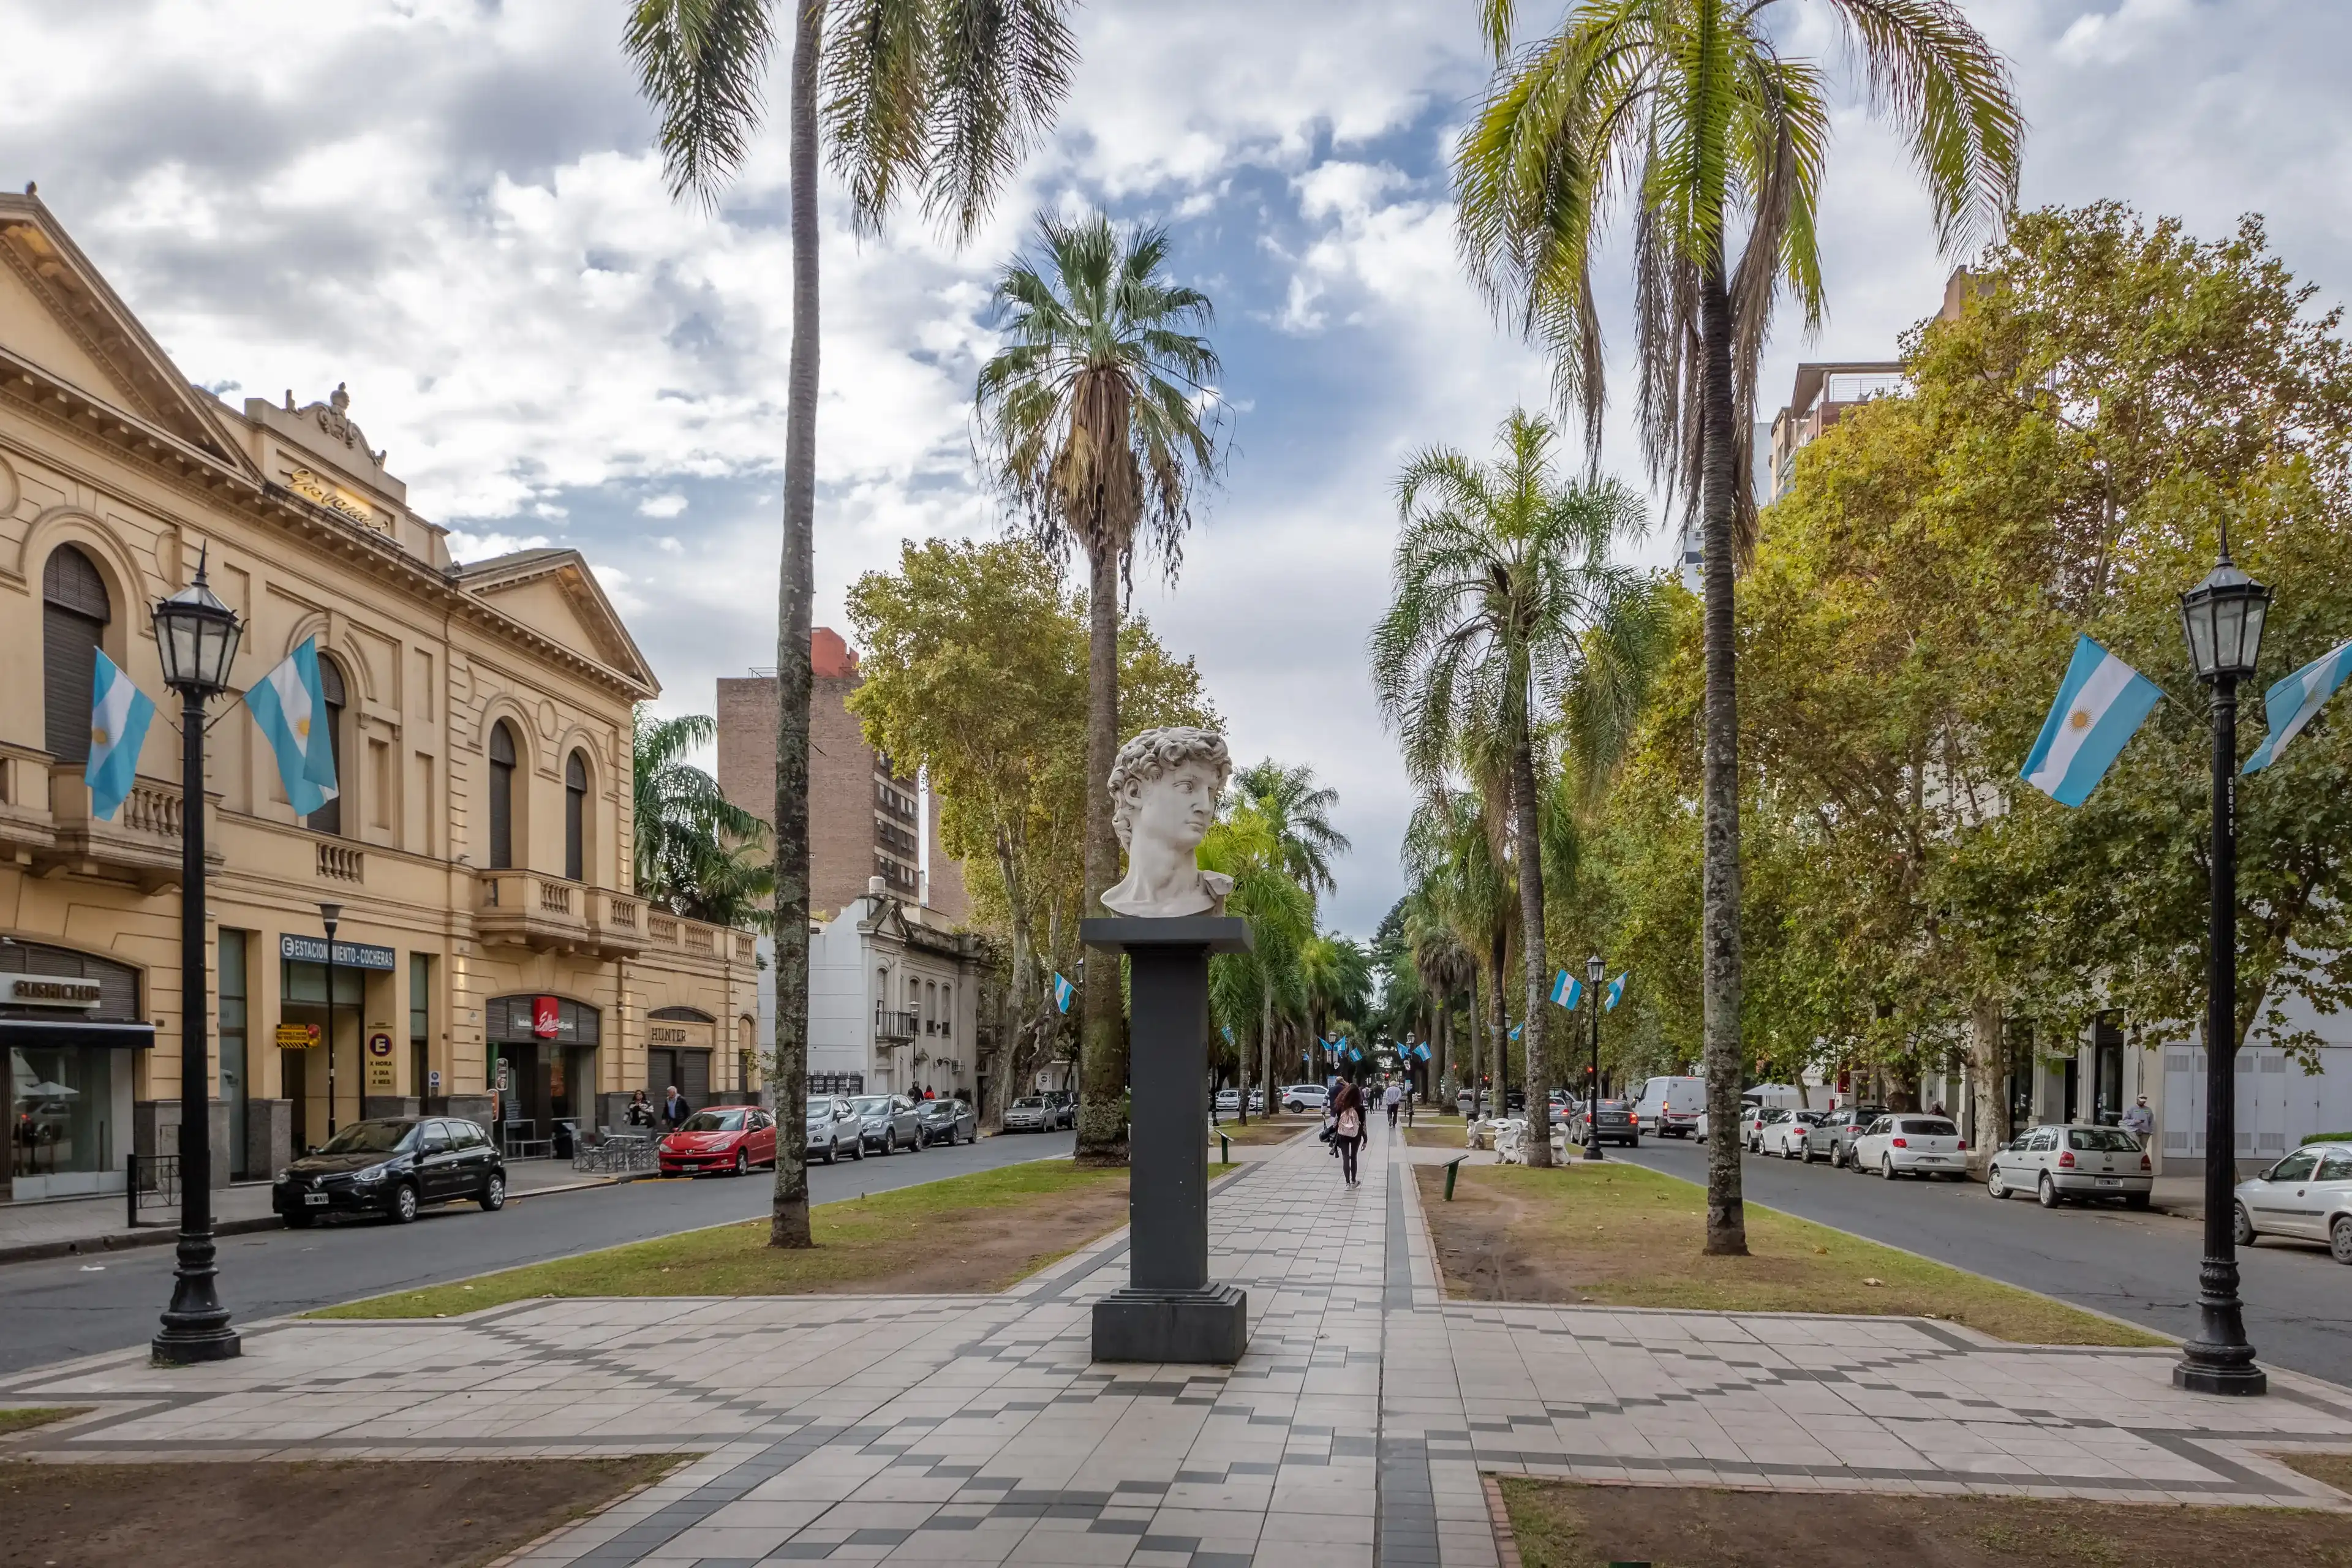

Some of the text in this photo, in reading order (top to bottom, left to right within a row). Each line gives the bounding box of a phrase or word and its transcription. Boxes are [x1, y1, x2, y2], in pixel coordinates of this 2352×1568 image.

[295, 940, 356, 963] ESTACIONMIENTO
[360, 949, 393, 967] COCHERAS
[652, 1028, 686, 1042] HUNTER
[375, 1038, 386, 1052] E
